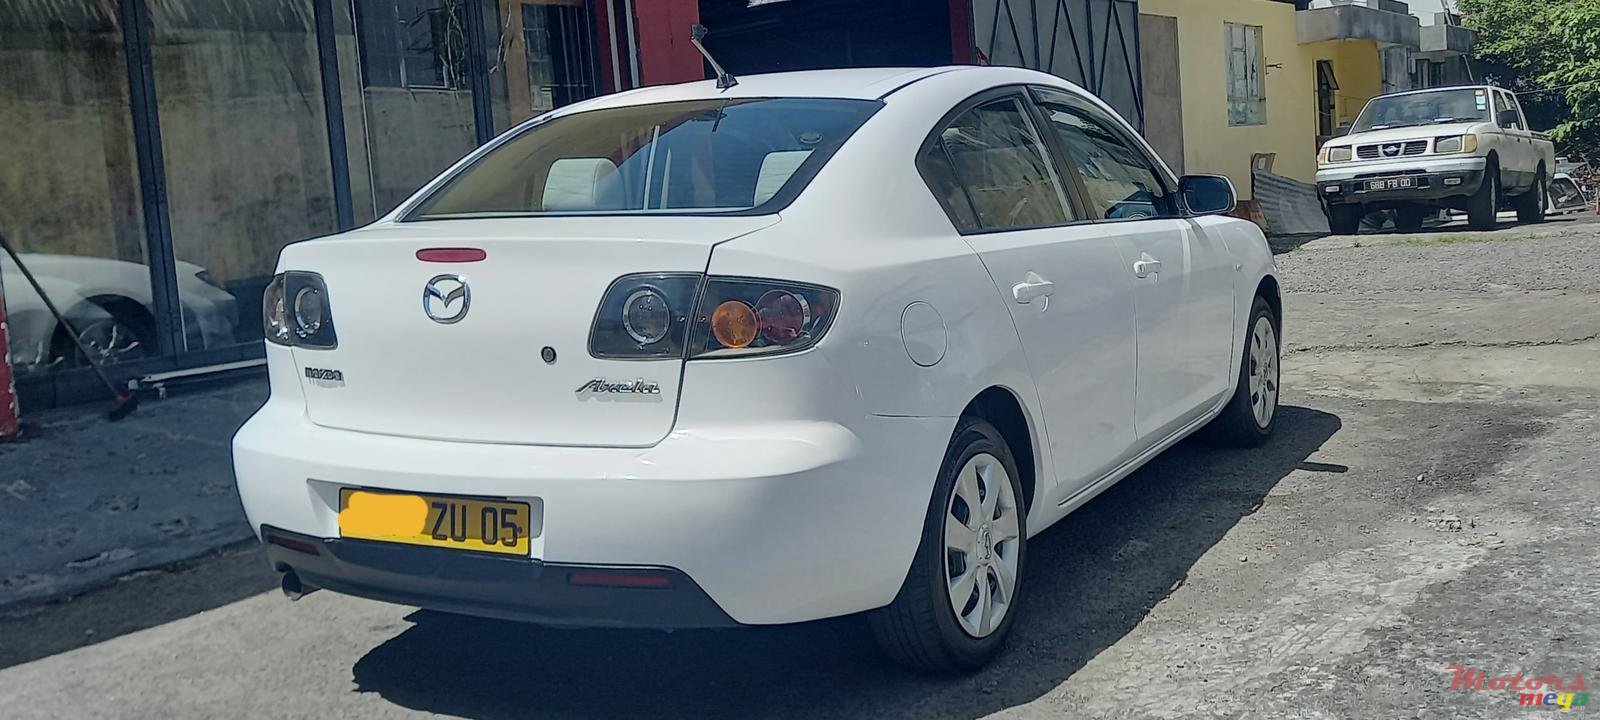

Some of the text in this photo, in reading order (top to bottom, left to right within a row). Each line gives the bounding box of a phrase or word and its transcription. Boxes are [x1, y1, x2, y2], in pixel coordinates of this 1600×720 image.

[574, 377, 661, 394] Axela
[431, 501, 518, 547] ZU 05
